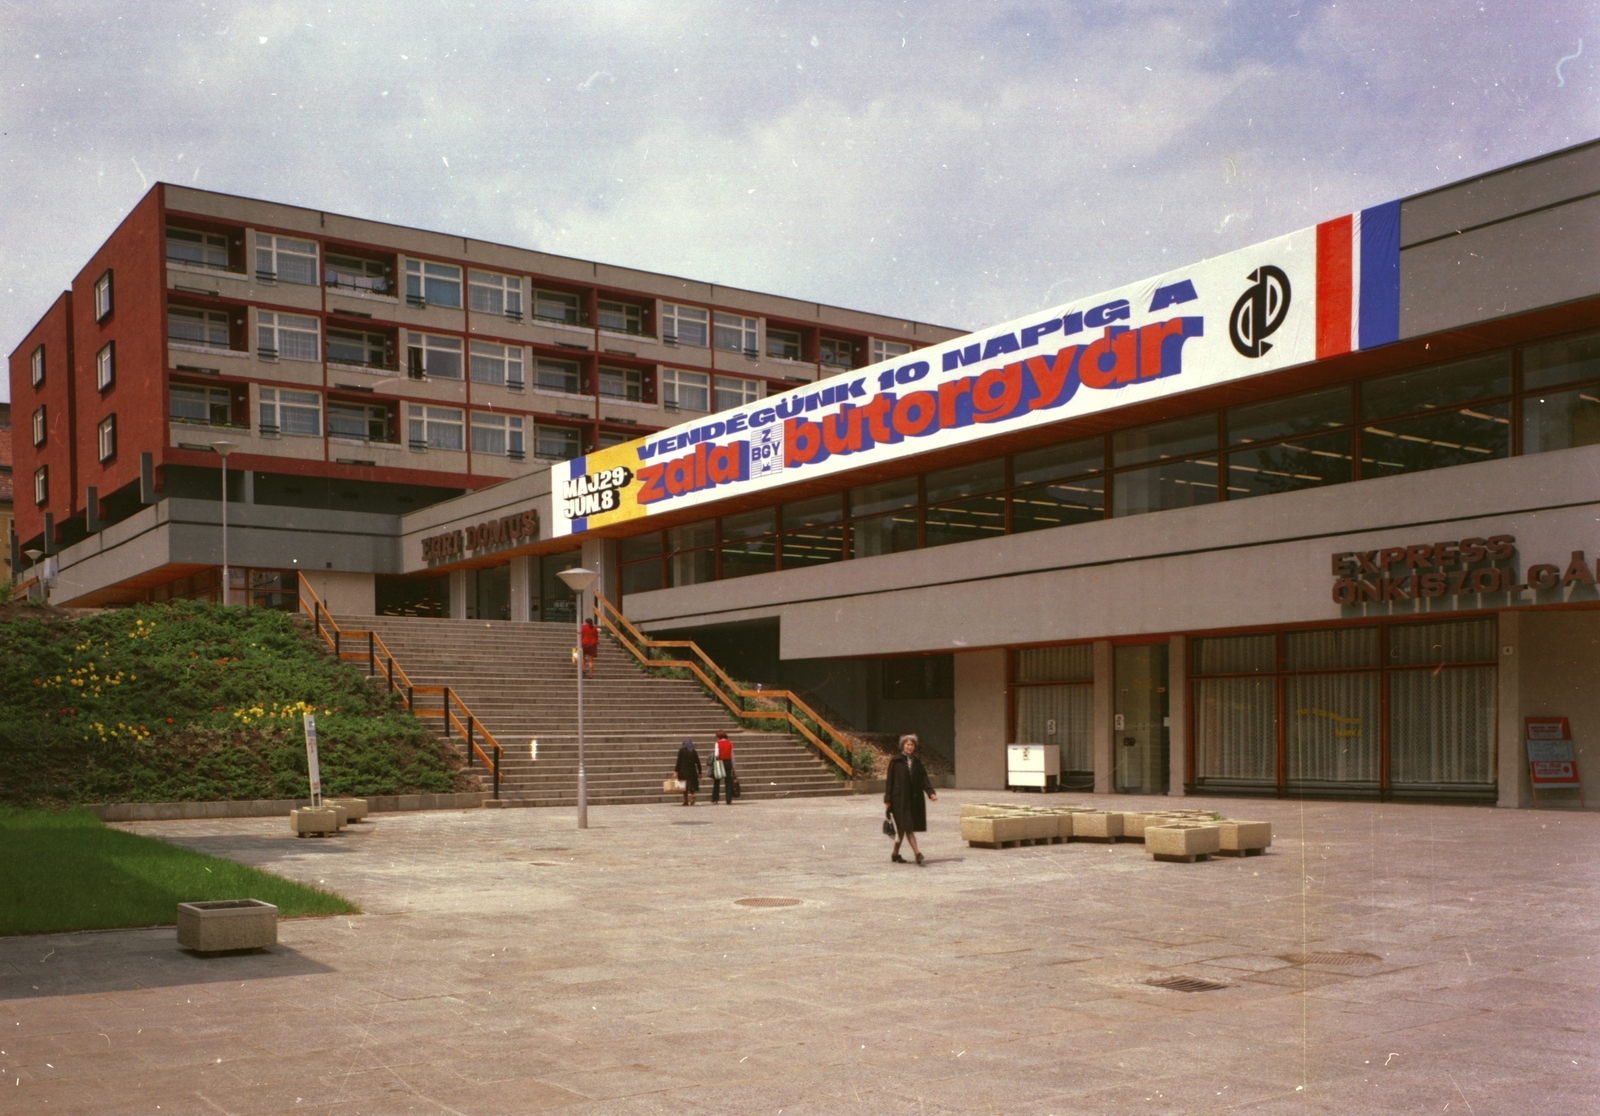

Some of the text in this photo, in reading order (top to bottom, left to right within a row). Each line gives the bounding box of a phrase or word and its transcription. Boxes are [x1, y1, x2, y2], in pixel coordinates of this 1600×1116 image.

[636, 278, 1199, 461] VENDÉGÜNK 10 NAPIG A
[751, 441, 781, 462] BGY
[761, 428, 772, 442] Z
[636, 439, 749, 505] zala
[421, 508, 537, 561] EGRI DOMUS
[1331, 534, 1516, 576] EXPRESS
[1332, 550, 1600, 605] ÖNKISZOLGÁ
